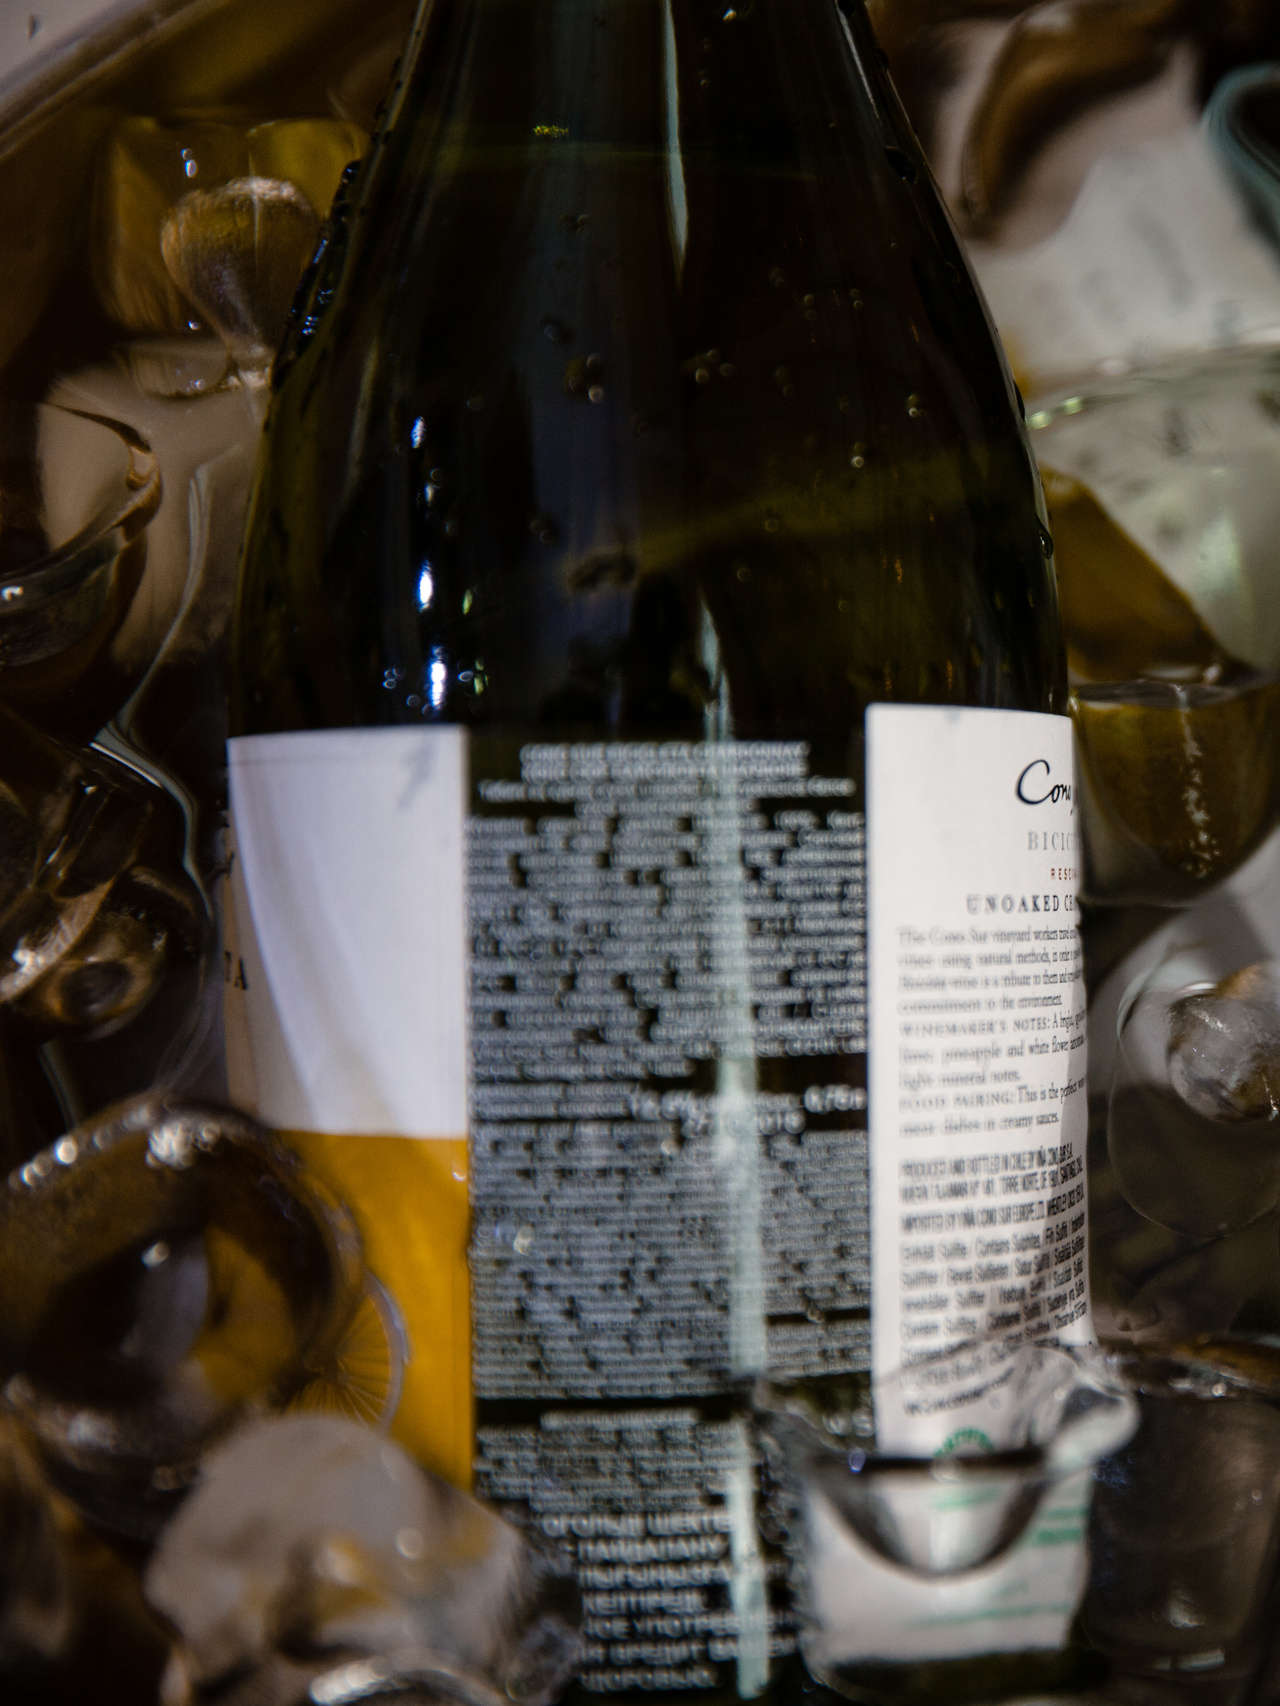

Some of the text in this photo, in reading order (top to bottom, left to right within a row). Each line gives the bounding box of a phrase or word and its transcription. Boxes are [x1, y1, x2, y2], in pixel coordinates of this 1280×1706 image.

[966, 894, 1060, 915] UNOAKED
[977, 949, 1012, 967] natural
[1002, 969, 1031, 987] tribute
[1013, 1016, 1051, 1033] NOTES:
[1006, 1038, 1024, 1057] and
[1016, 1083, 1038, 1103] This
[1040, 1084, 1047, 1101] is
[1048, 1081, 1060, 1100] the
